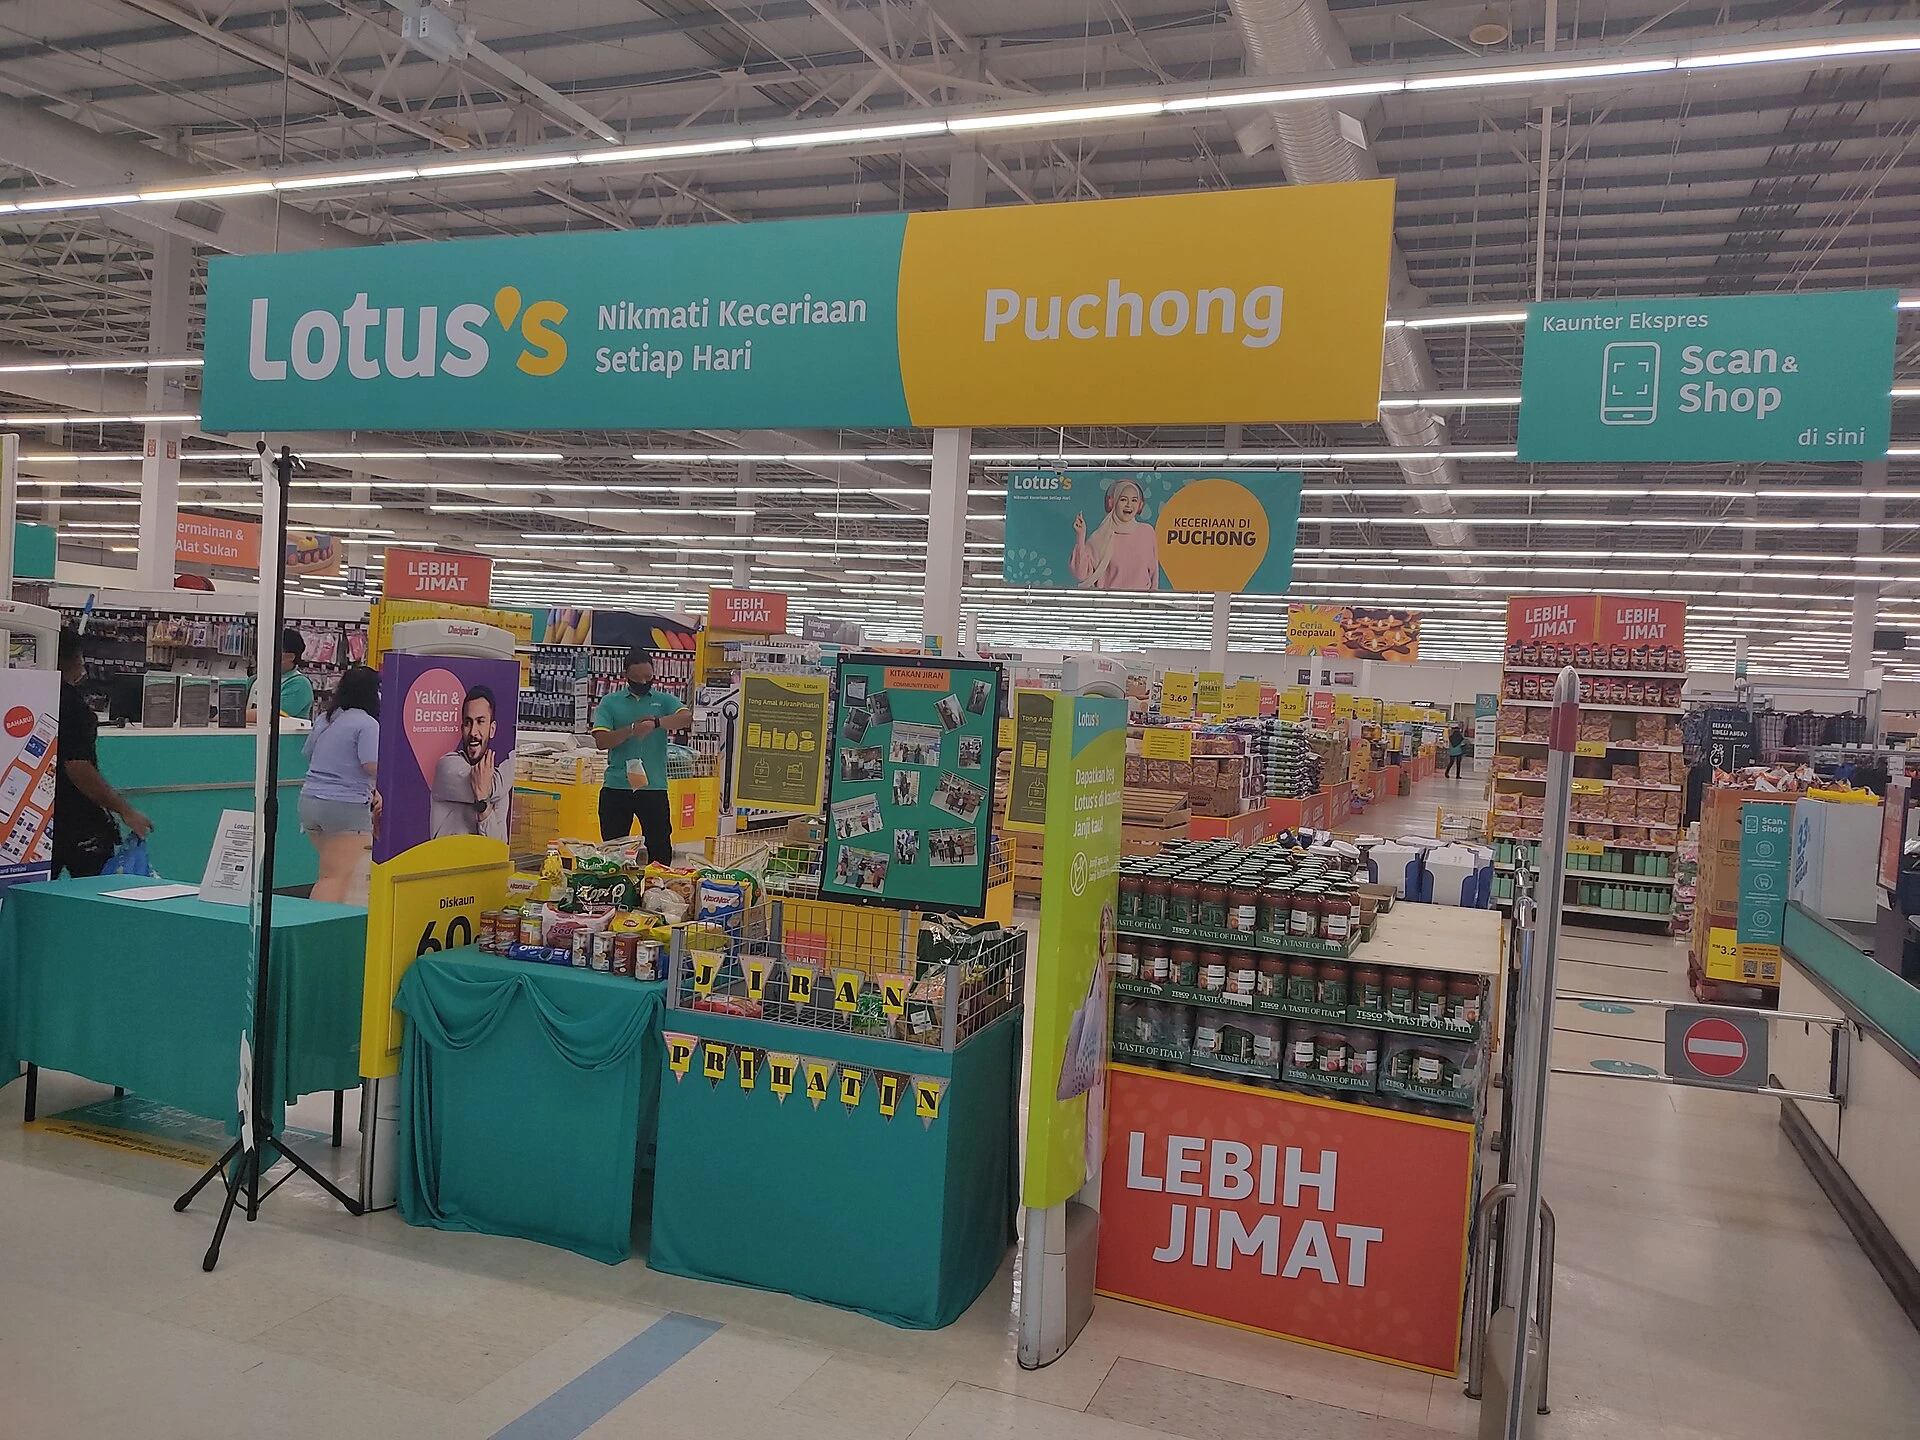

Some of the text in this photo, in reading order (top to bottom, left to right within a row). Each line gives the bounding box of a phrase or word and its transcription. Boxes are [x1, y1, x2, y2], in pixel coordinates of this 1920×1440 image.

[598, 293, 867, 331] Nikmati Keceriaan
[984, 279, 1284, 348] Puchong
[1543, 312, 1709, 332] Kaunter Ekspres
[248, 285, 569, 381] Lotus's
[595, 339, 752, 378] Setiap Hari
[1681, 345, 1799, 375] Scan &
[1679, 381, 1781, 419] Shop
[1799, 427, 1865, 445] di sini
[1014, 475, 1072, 490] Lotus's
[1174, 518, 1250, 528] KECERIAAN DI
[178, 522, 244, 541] ermainan &
[1167, 530, 1256, 546] PUCHONG
[175, 540, 238, 558] Alat Sukan
[408, 561, 459, 576] LEBIH
[416, 577, 469, 591] JIMAT
[726, 597, 764, 610] LEBIH
[732, 610, 771, 622] JIMAT
[1525, 604, 1569, 624] LEBIH
[1616, 608, 1659, 624] LEBIH
[1290, 628, 1336, 639] Deepavali
[1300, 621, 1323, 630] Ceria
[1530, 619, 1577, 639] JIMAT
[1622, 624, 1667, 640] JIMAT
[889, 669, 944, 680] KITAKAN JIRAN
[414, 690, 460, 705] Yakin &
[748, 698, 761, 706] Tong
[779, 700, 820, 710] #JiranPrihatin
[1169, 693, 1188, 703] 3.69
[5, 714, 35, 729] BAHARU!
[415, 708, 458, 722] Berseri
[1021, 714, 1052, 723] Tong Ama
[1078, 710, 1100, 728] Lotus's
[438, 725, 458, 733] Lotus's
[1075, 767, 1115, 788] Dapatkan beg
[1074, 791, 1098, 812] Lotus's
[1098, 789, 1104, 808] di
[1762, 816, 1783, 825] Scan
[1072, 820, 1090, 839] Janji
[1761, 825, 1784, 835] Shop
[439, 895, 475, 909] Diskaun
[1118, 919, 1134, 928] ASTE
[1144, 922, 1163, 930] ITALY
[1171, 926, 1190, 935] TESCO
[1199, 929, 1218, 938] TASTE
[1219, 931, 1229, 940] OF
[1230, 933, 1249, 942] ITALY
[1262, 935, 1282, 945] TESCO
[1288, 939, 1312, 950] TASTE
[1312, 941, 1324, 950] OF
[1323, 942, 1343, 952] ITALY
[1720, 946, 1737, 956] 3.2
[695, 964, 904, 1007] JIRAN
[1133, 984, 1143, 992] OF
[1143, 986, 1162, 996] ITALY
[1171, 990, 1190, 999] TESCO
[1198, 994, 1219, 1003] TASTE
[1260, 1001, 1279, 1010] TESCO
[1287, 1004, 1310, 1015] TASTE
[1311, 1006, 1322, 1015] OF
[1321, 1007, 1341, 1018] ITALY
[1356, 1009, 1383, 1022] TESCO
[1386, 1015, 1395, 1024] A
[1397, 1013, 1428, 1028] TASTE
[1429, 1018, 1444, 1029] OF
[1118, 1041, 1145, 1053] TASTE
[1145, 1045, 1159, 1055] OF
[1159, 1047, 1185, 1060] ITALY
[672, 1044, 940, 1111] PRIHATIN
[1317, 1074, 1340, 1083] TASTE
[1340, 1076, 1349, 1084] OF
[1350, 1078, 1371, 1087] ITALY
[1385, 1079, 1404, 1088] TESCO
[1415, 1084, 1436, 1094] TASTE
[1436, 1087, 1447, 1096] OF
[1447, 1089, 1469, 1099] ITALY
[1126, 1131, 1338, 1212] LEBIH
[1152, 1203, 1383, 1288] JIMAT
